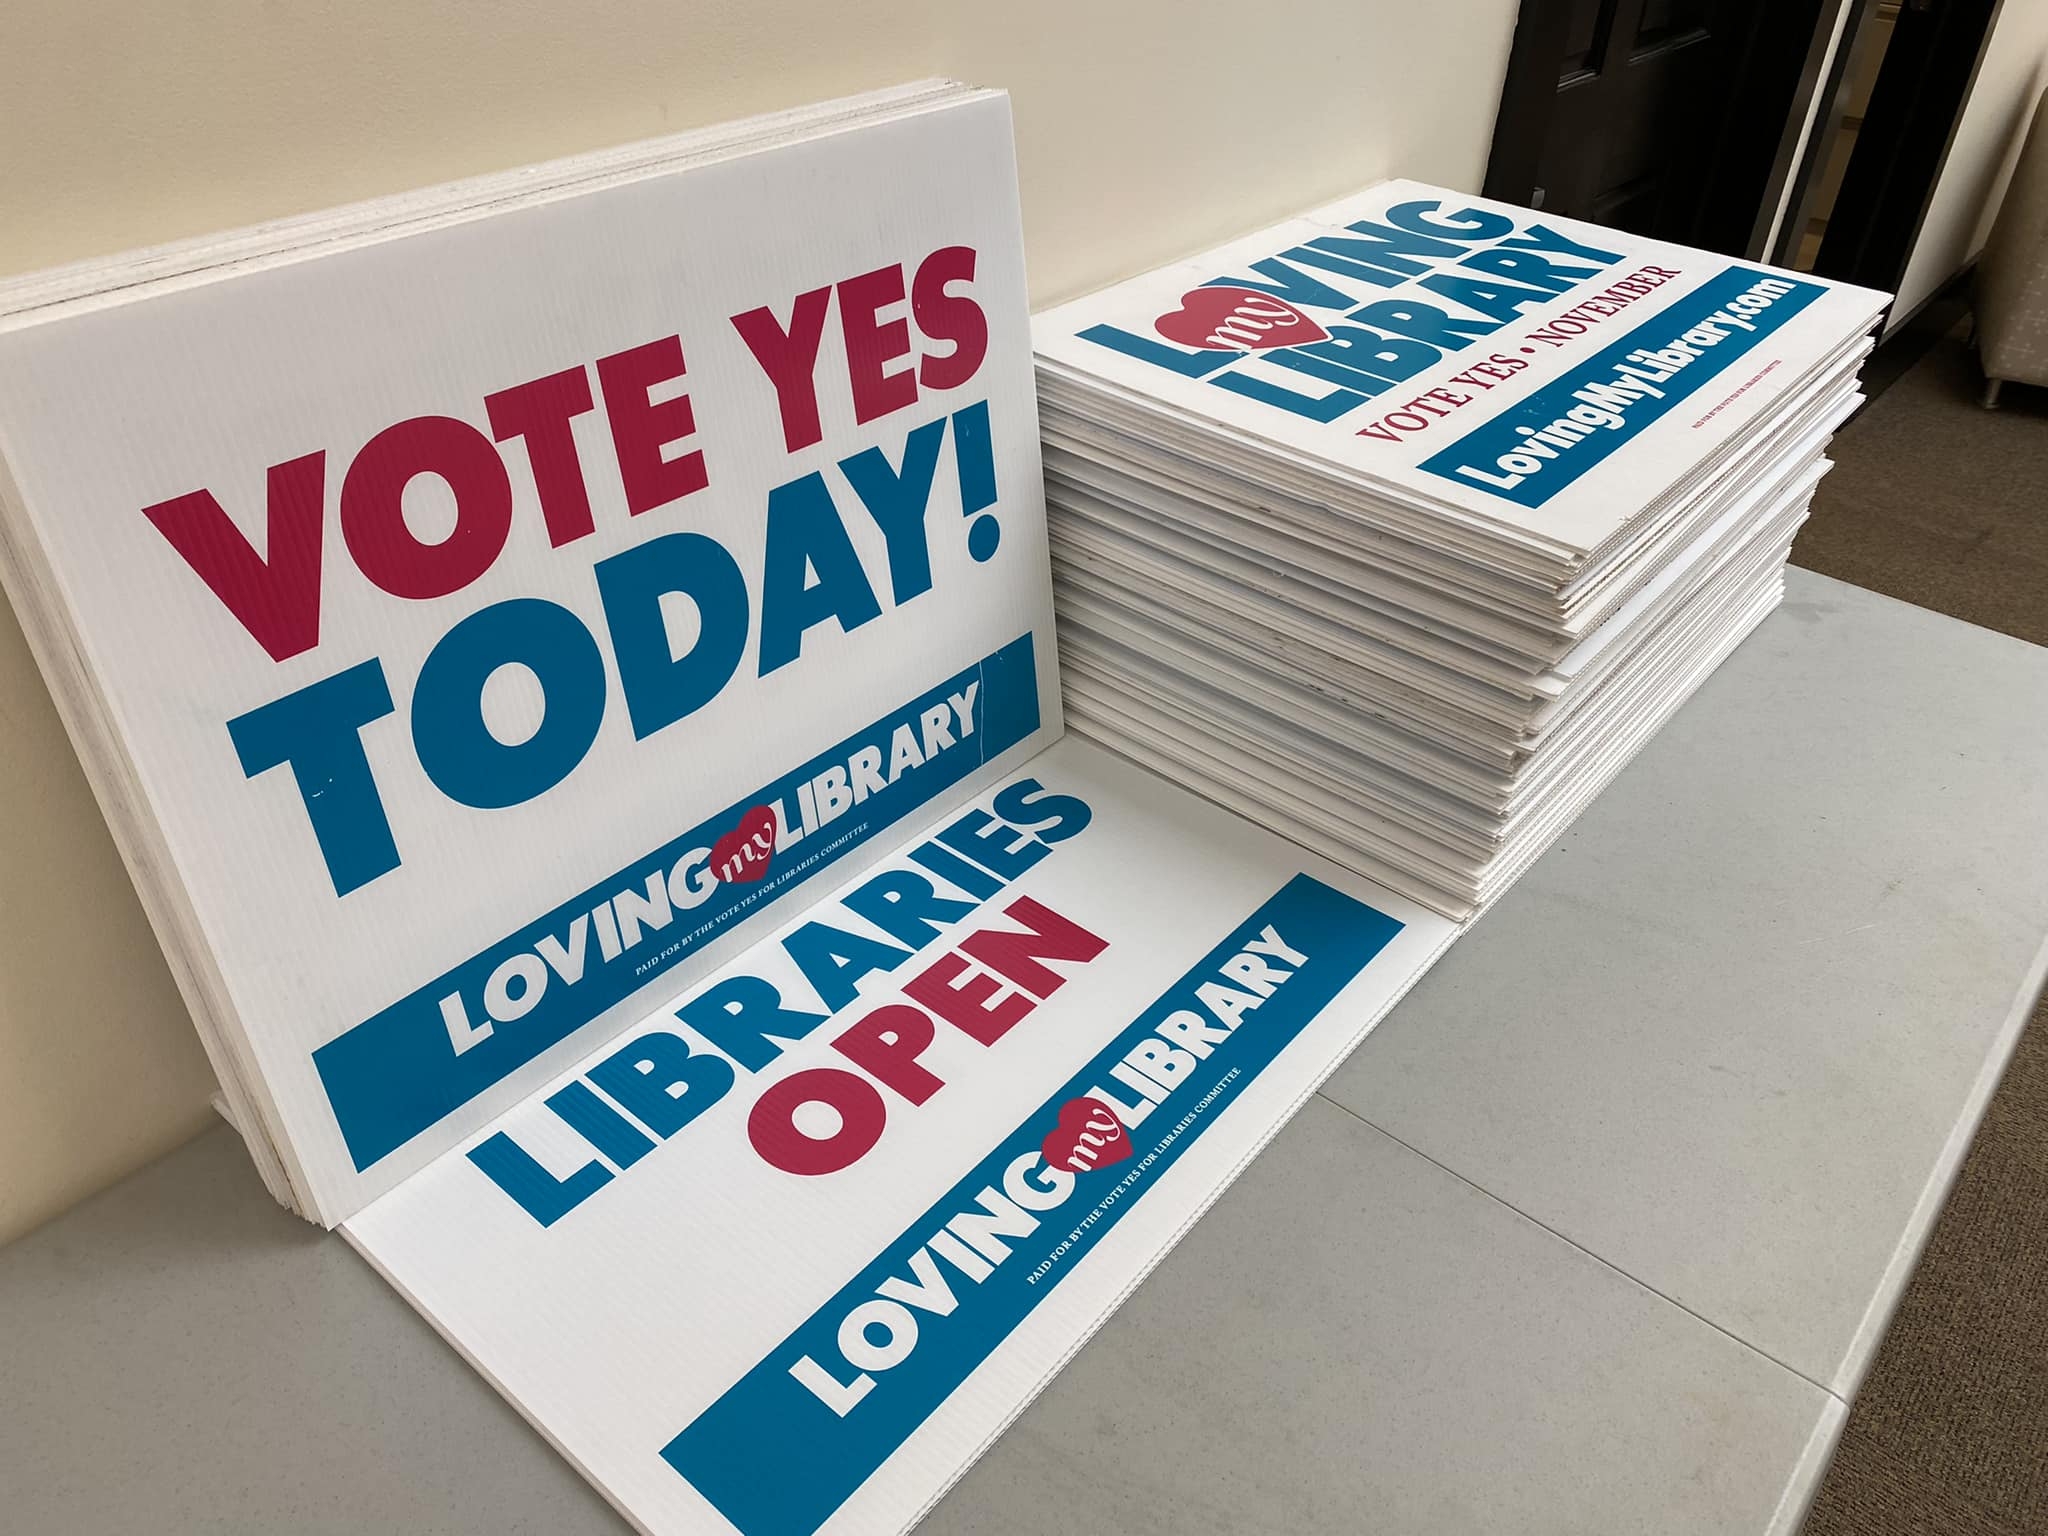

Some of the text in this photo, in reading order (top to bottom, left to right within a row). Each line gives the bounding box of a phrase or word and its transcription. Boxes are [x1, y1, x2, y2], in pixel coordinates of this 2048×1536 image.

[1074, 200, 1515, 379] LVING
[1205, 296, 1300, 351] my
[1207, 224, 1628, 424] LIBRARY
[1356, 264, 1682, 445] VOTE YES NOVEMBER
[1455, 277, 1797, 491] LovingMyLibrary.com
[141, 246, 989, 663] VOTE YES
[226, 399, 1001, 898] TODAY!
[437, 681, 979, 1056] LOVING my LIBRARY
[635, 822, 869, 976] PAID FOR BY THE VOTE YES FOR LIBRARIES COMMITTEE
[465, 777, 1093, 1229] LIBRARIES
[747, 895, 1110, 1177] OPEN
[787, 924, 1309, 1419] LOVING my LIBRARY
[1026, 1067, 1241, 1285] PAID FOR BY THE VOTE YES FOR LIBRARIES COMMITTEE
